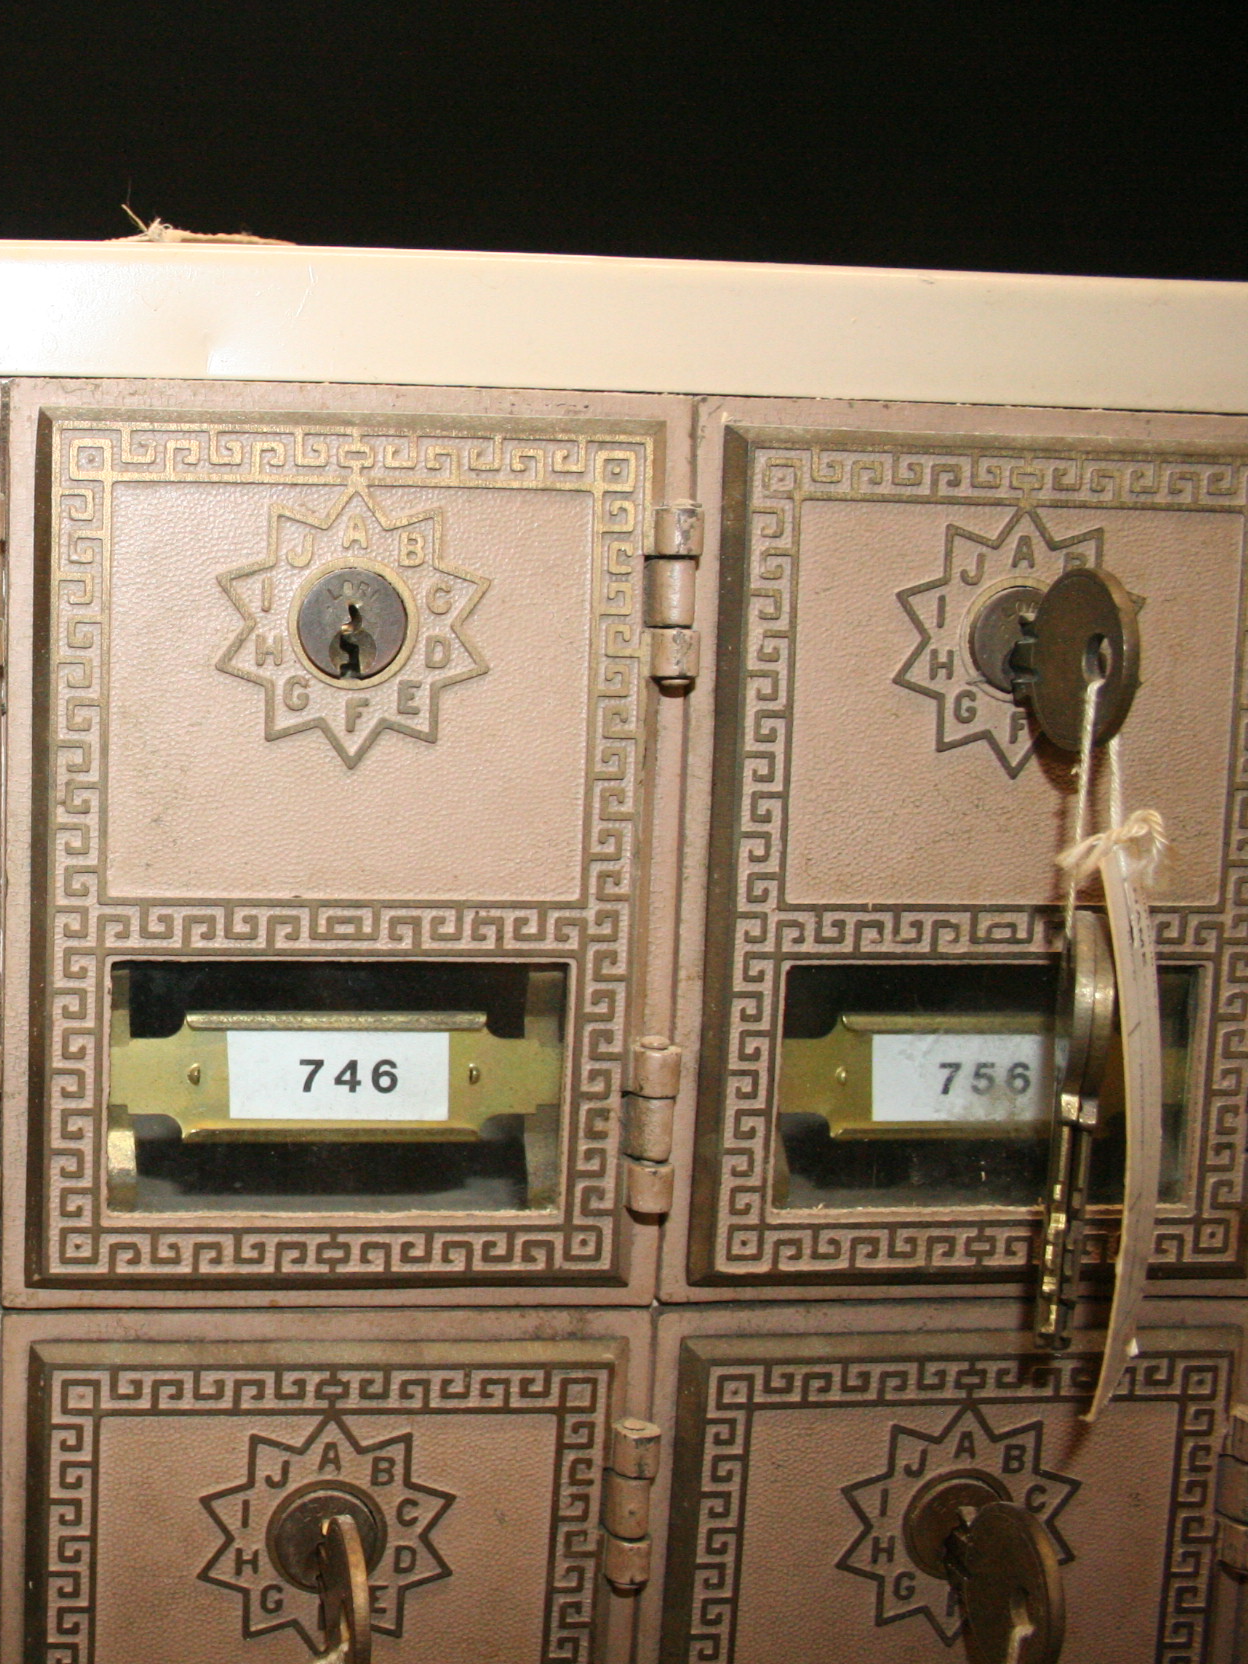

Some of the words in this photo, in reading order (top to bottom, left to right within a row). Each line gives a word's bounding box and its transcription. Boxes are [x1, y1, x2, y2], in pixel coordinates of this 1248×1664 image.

[343, 515, 368, 549] A
[286, 532, 313, 567] J
[398, 532, 425, 567] B
[1011, 535, 1035, 568] A
[960, 552, 986, 586] J
[261, 577, 272, 612] I
[426, 581, 452, 614] C
[936, 594, 946, 628] I
[255, 634, 282, 666] H
[425, 635, 451, 668] D
[929, 648, 954, 680] H
[283, 675, 310, 711] G
[397, 680, 422, 714] E
[954, 690, 976, 724] G
[345, 698, 369, 732] F
[298, 1059, 399, 1094] 746
[938, 1061, 1032, 1096] 756
[318, 1442, 342, 1472] A
[953, 1431, 976, 1459] A
[1002, 1444, 1027, 1473] B
[265, 1460, 290, 1489] J
[370, 1456, 396, 1486] B
[903, 1448, 927, 1478] J
[241, 1499, 250, 1529] I
[396, 1498, 420, 1527] C
[879, 1488, 889, 1517] I
[1024, 1485, 1047, 1513] C
[235, 1547, 259, 1576] H
[394, 1545, 417, 1574] D
[871, 1536, 896, 1564] H
[260, 1584, 283, 1614] G
[893, 1571, 916, 1600] G
